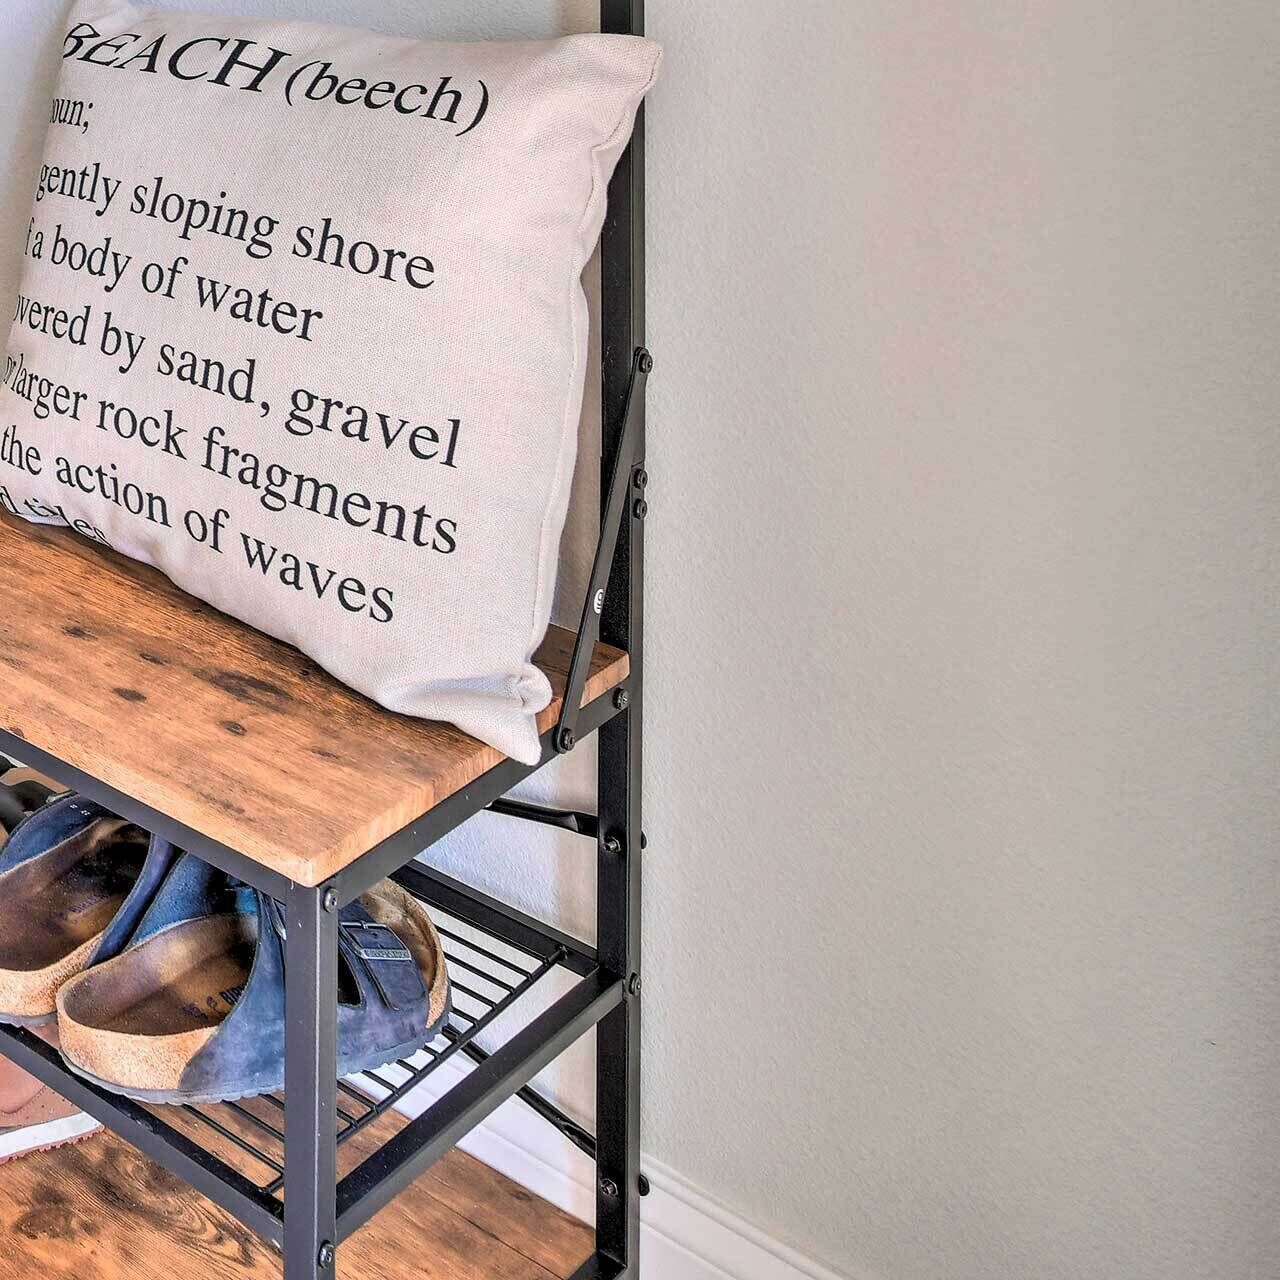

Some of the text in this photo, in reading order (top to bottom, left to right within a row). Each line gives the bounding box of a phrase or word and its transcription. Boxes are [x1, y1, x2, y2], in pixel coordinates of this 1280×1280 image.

[48, 98, 94, 135] oun;
[62, 22, 489, 137] BEACH (beech)
[32, 231, 44, 260] a
[51, 223, 133, 293] body
[142, 256, 189, 300] of
[196, 272, 324, 342] water
[35, 162, 435, 289] gently sloping shore
[10, 352, 88, 421] larger
[96, 400, 188, 461] rock
[200, 426, 458, 554] fragments
[100, 311, 147, 374] by
[157, 343, 270, 418] sand,
[284, 388, 461, 469] gravel
[0, 424, 43, 476] the
[55, 456, 172, 528] action
[183, 508, 230, 554] of
[239, 532, 394, 623] waves
